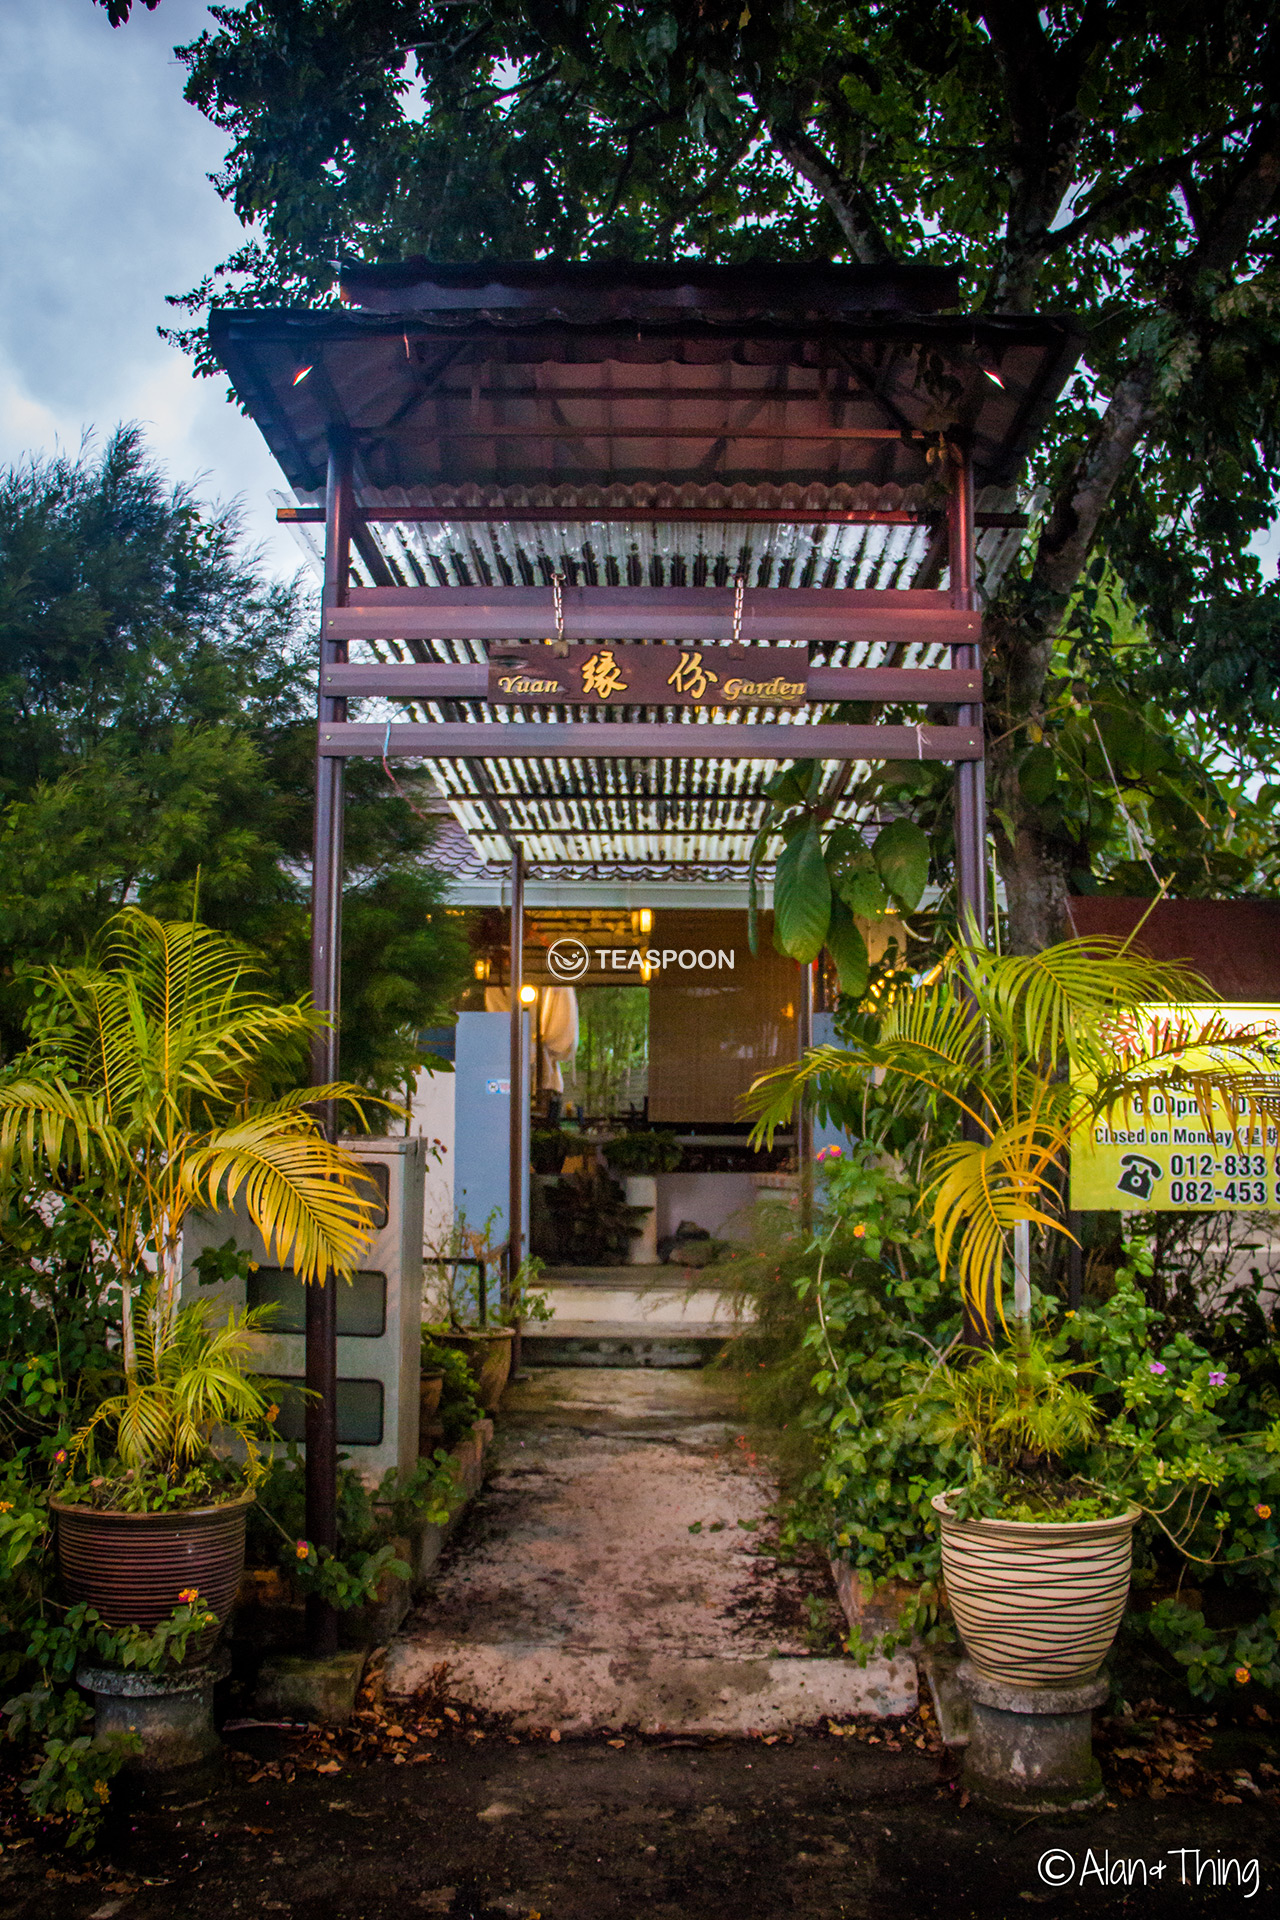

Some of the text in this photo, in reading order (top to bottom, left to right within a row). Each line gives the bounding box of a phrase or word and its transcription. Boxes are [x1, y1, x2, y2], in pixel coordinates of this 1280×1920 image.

[498, 675, 559, 694] Yuan
[723, 677, 806, 700] Garden
[1095, 1128, 1145, 1144] Closed
[1150, 1131, 1168, 1144] on
[1171, 1154, 1266, 1176] 012-833
[1171, 1181, 1266, 1203] 082-453
